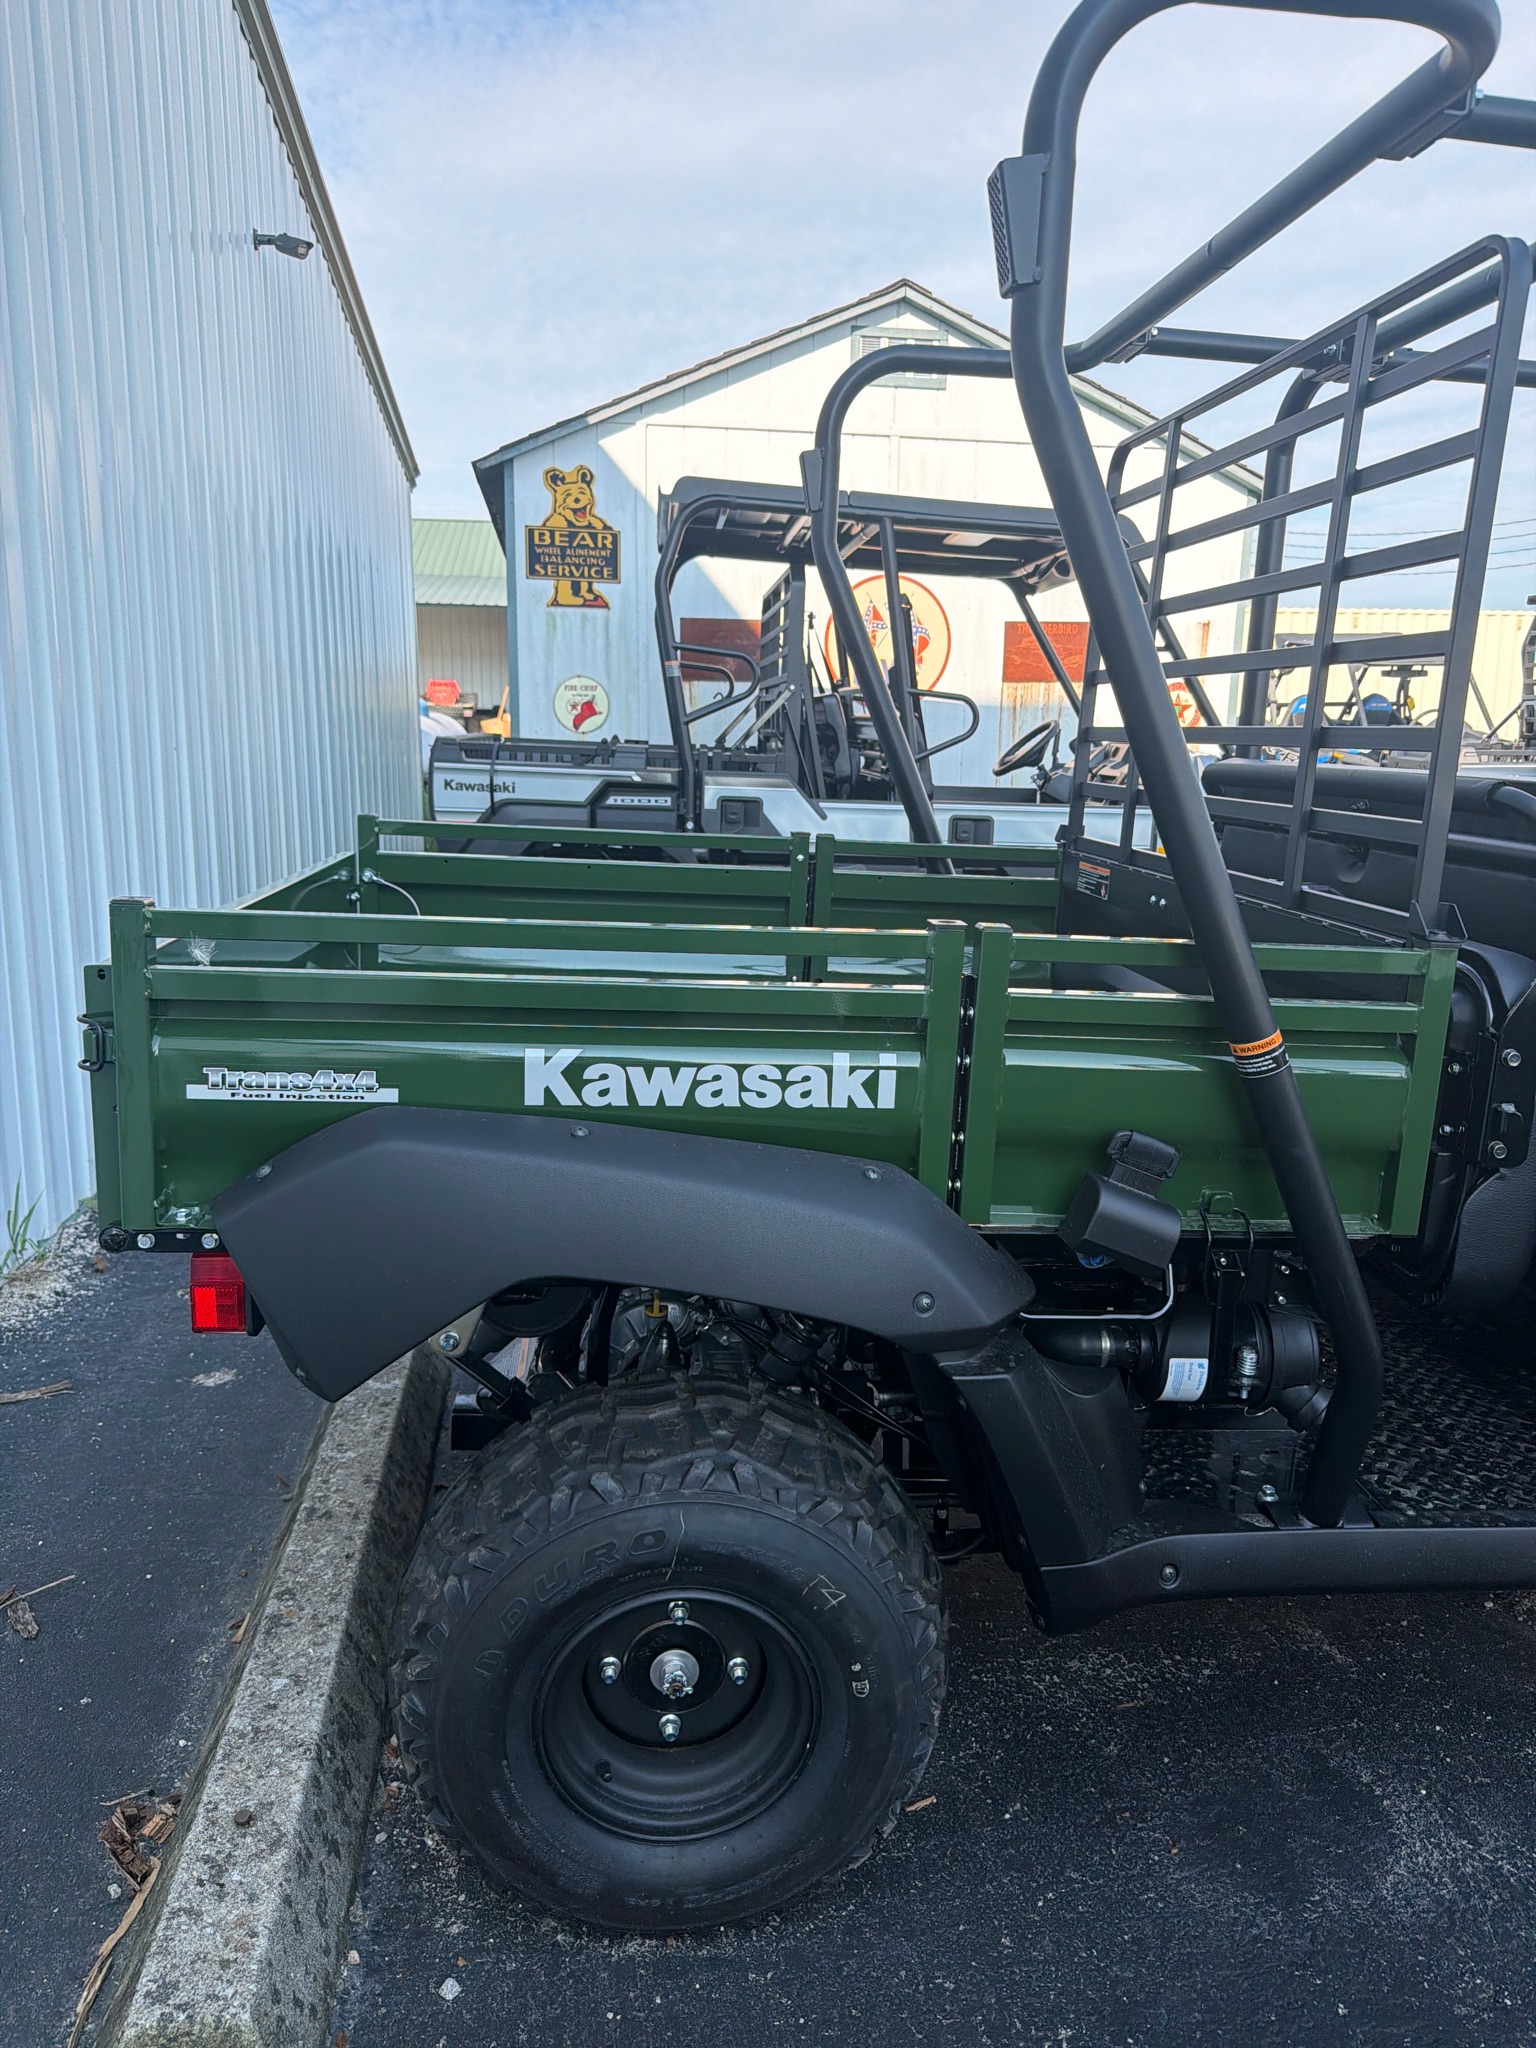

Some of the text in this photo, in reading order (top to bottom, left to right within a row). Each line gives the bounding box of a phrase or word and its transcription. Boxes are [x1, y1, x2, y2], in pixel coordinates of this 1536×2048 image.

[533, 530, 613, 549] BEAR
[535, 547, 611, 557] WHEEL ALINEMENT
[541, 555, 606, 566] BALANCING
[534, 564, 613, 579] SERVICE
[1017, 624, 1079, 635] THDERBIRD
[443, 778, 516, 794] Kawasaki
[1239, 1038, 1277, 1054] WARNING
[203, 1067, 379, 1091] Trans4x4
[524, 1047, 898, 1109] Kawasaki
[500, 1529, 669, 1640] DURO
